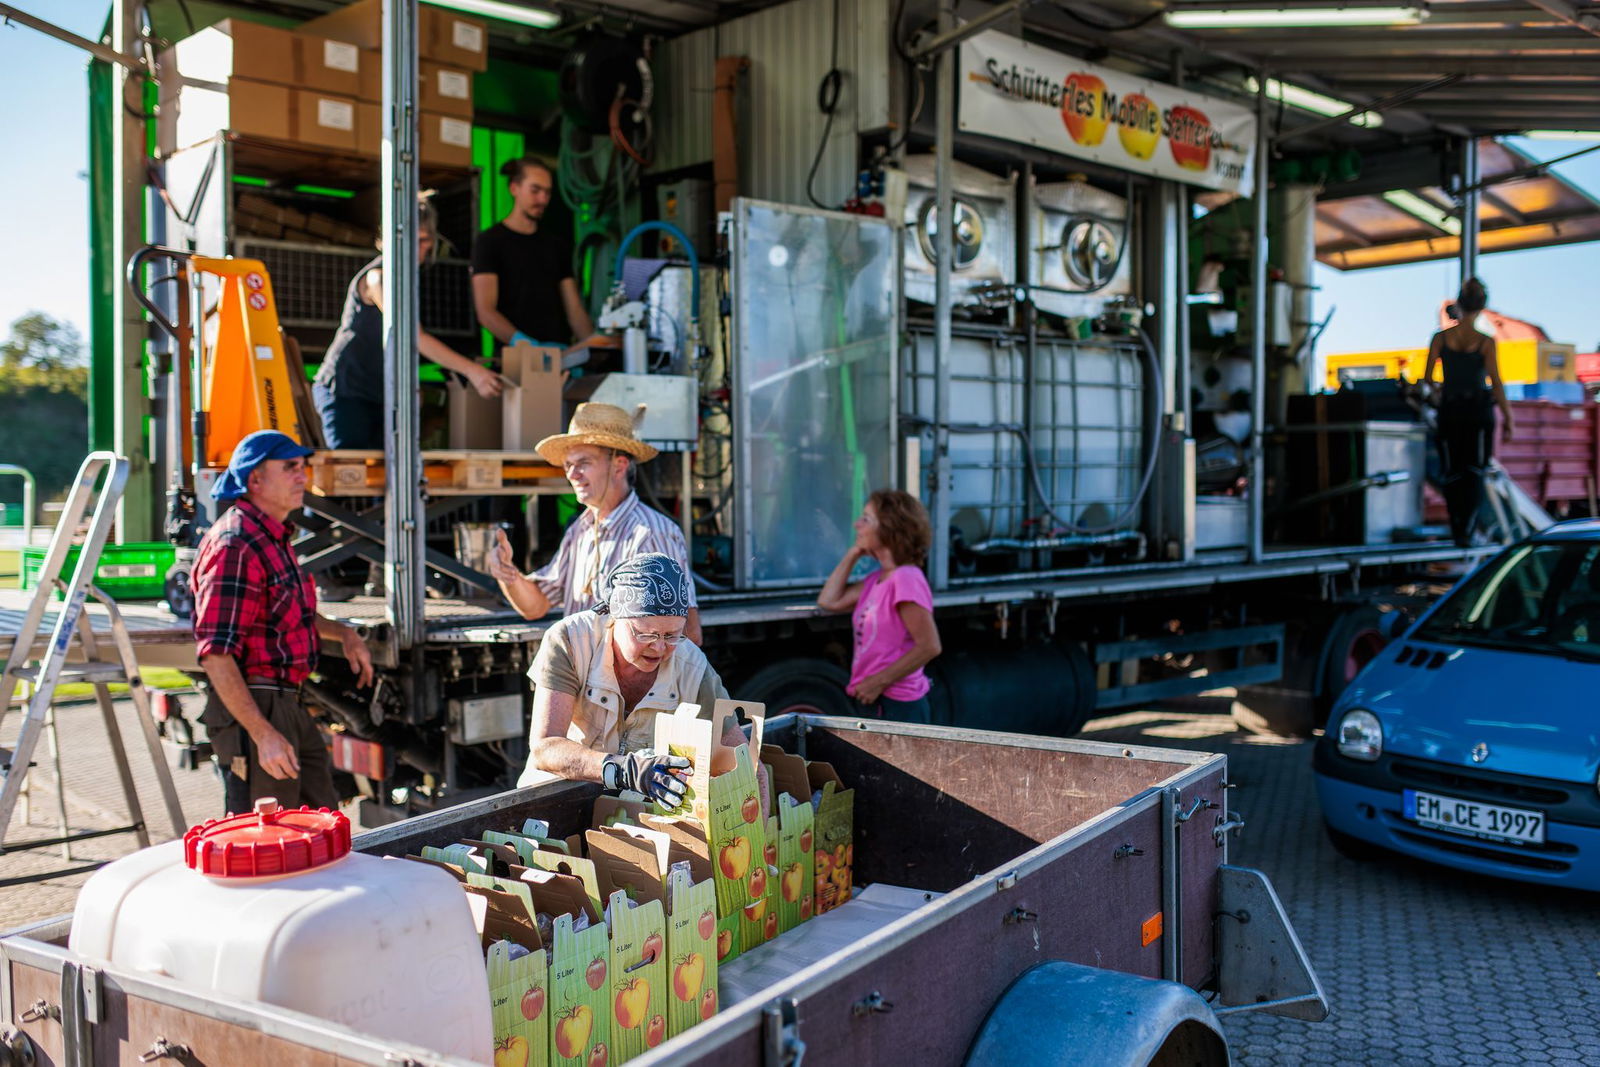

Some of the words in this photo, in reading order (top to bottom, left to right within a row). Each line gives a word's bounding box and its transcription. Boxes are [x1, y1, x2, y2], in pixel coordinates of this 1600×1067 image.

[984, 57, 1096, 117] Schütterles
[1101, 89, 1159, 134] Mobile
[715, 807, 720, 815] 5
[720, 802, 732, 813] Liter
[1416, 795, 1441, 820] EM
[1455, 803, 1481, 828] CE
[1487, 809, 1542, 838] 1997
[616, 896, 621, 904] 2
[561, 920, 565, 928] 2
[675, 922, 680, 930] 5
[679, 918, 690, 929] Liter
[496, 948, 501, 956] 2
[616, 946, 621, 954] 5
[620, 942, 633, 953] Liter
[556, 972, 562, 980] 5
[561, 967, 575, 979] Liter
[493, 995, 508, 1008] Liter
